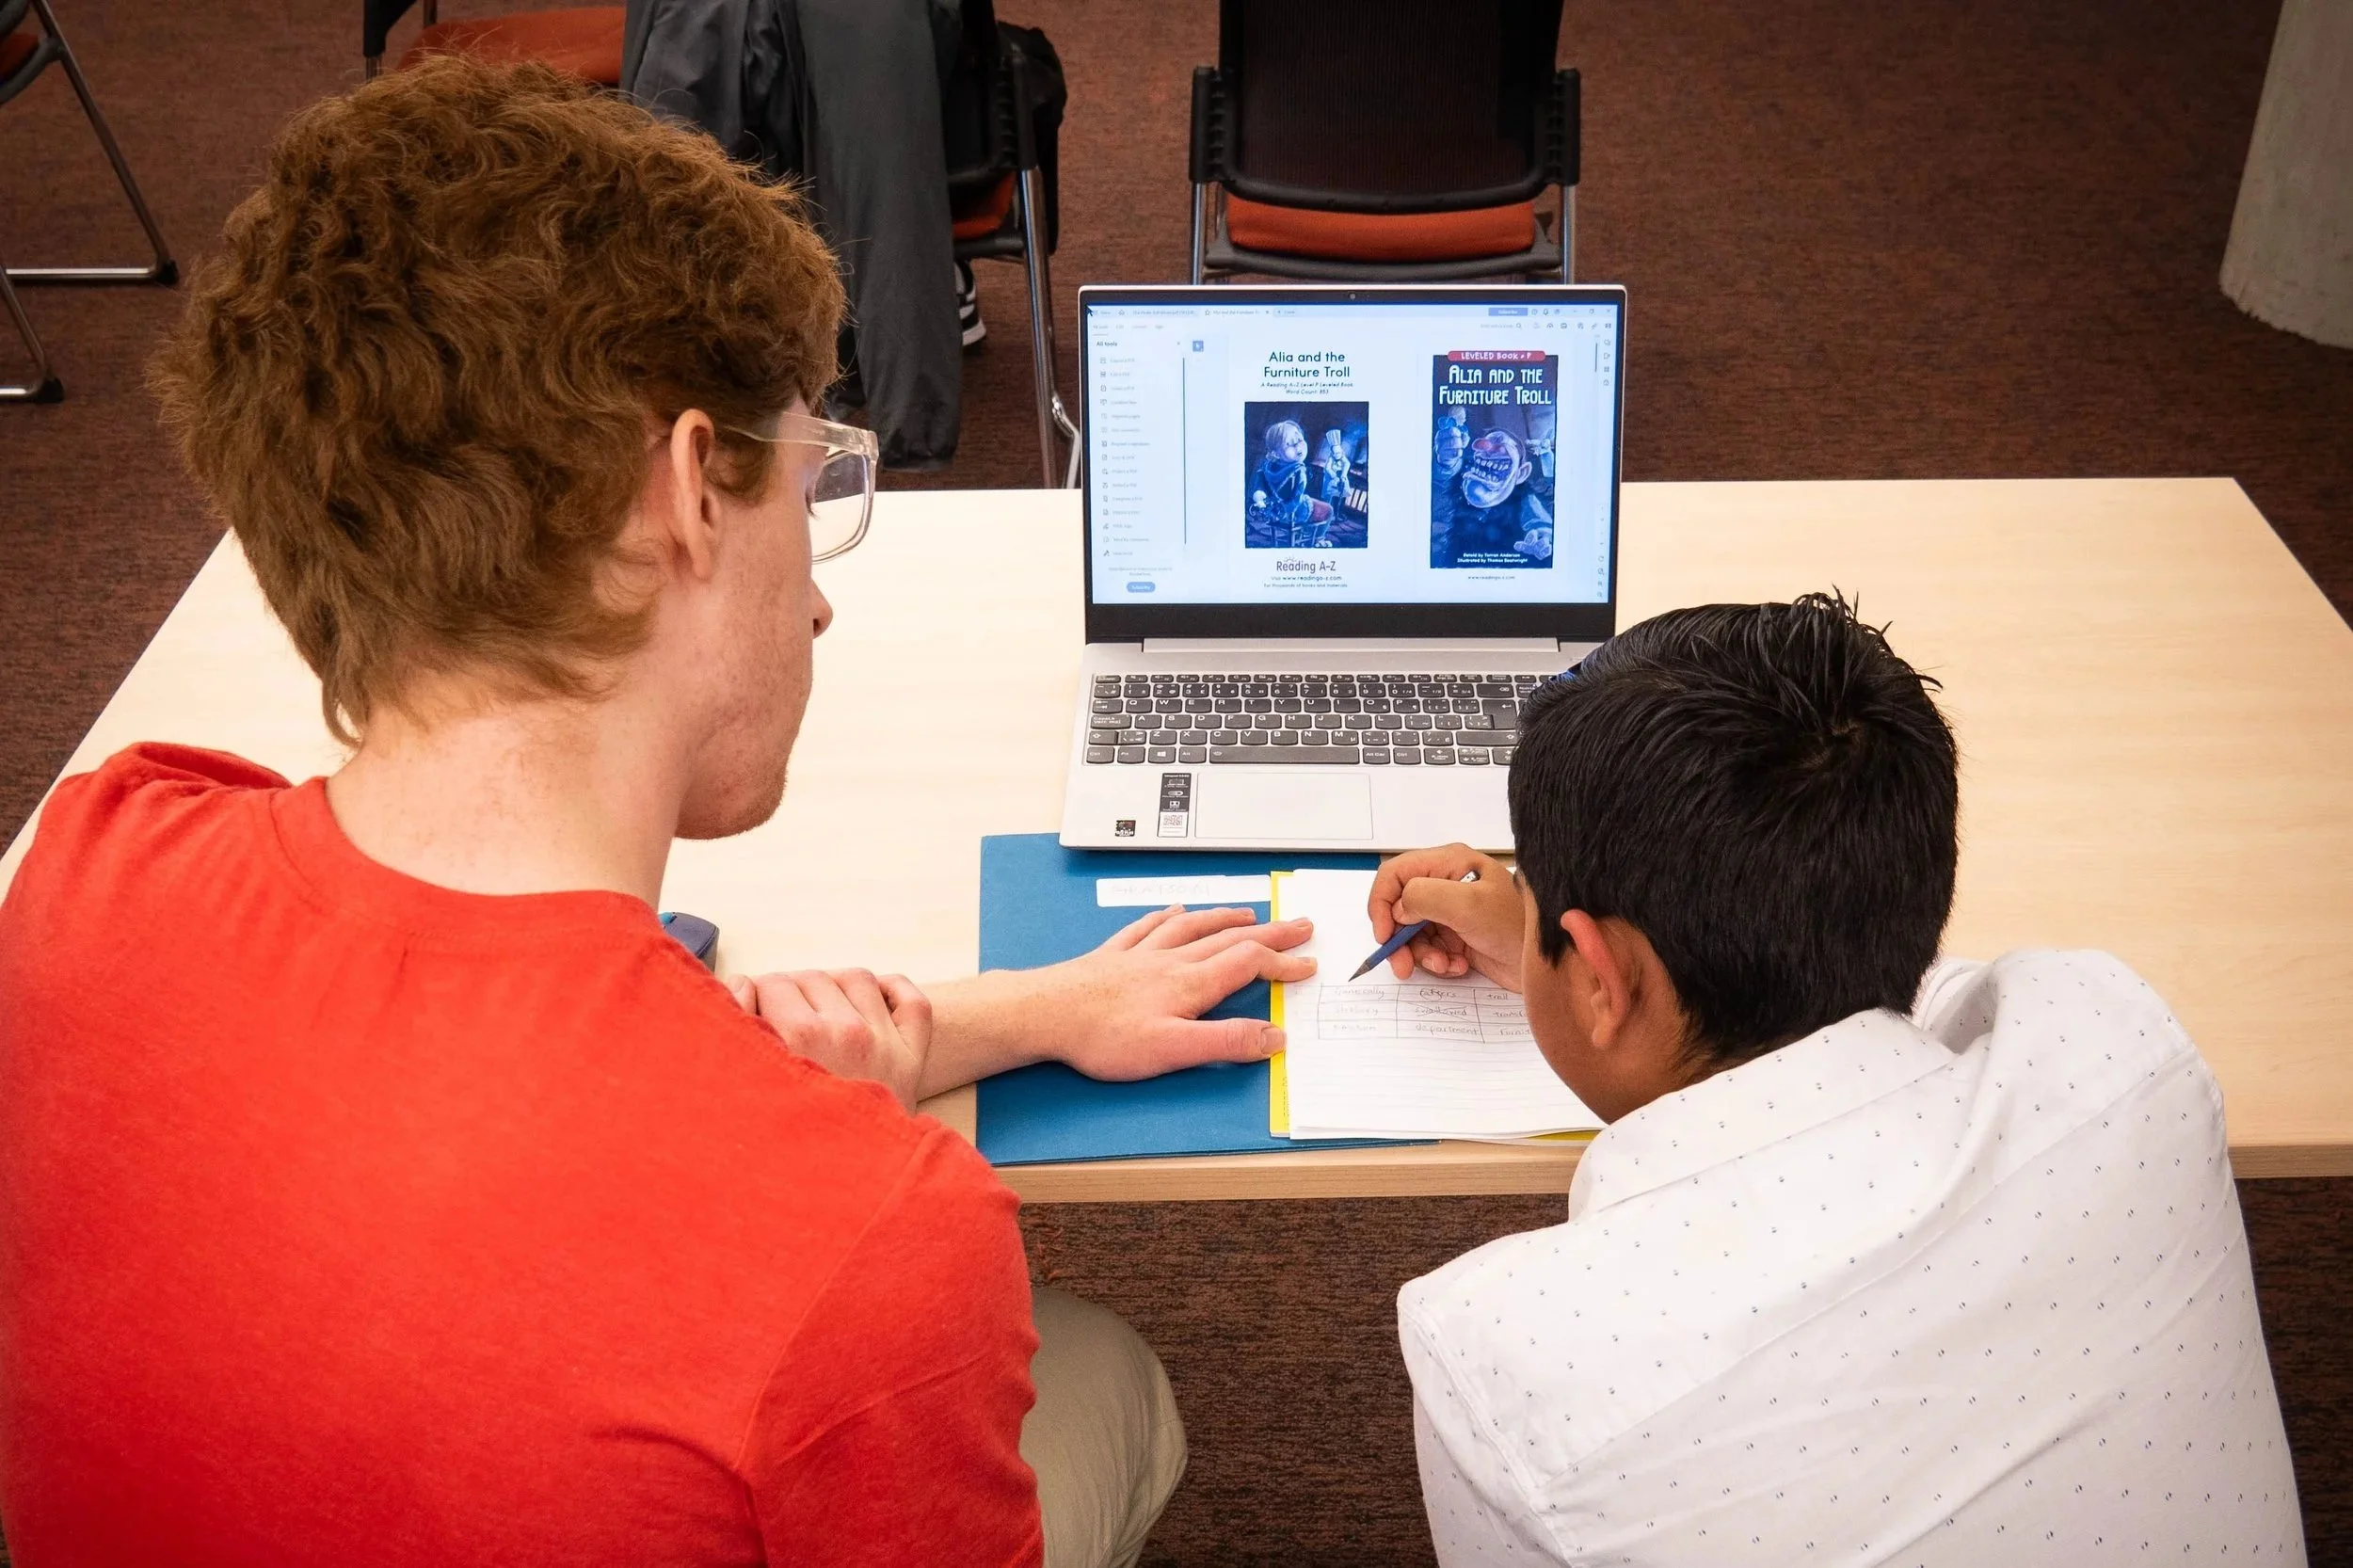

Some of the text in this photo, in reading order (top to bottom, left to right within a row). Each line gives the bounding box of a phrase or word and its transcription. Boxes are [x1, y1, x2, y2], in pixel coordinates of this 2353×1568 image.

[1269, 351, 1346, 362] Alia and the
[1264, 366, 1351, 377] Furniture Troll
[1449, 364, 1544, 384] ALIA AND THE
[1439, 385, 1552, 405] FURNITURE TROLL
[1276, 560, 1337, 574] Reading A-Z
